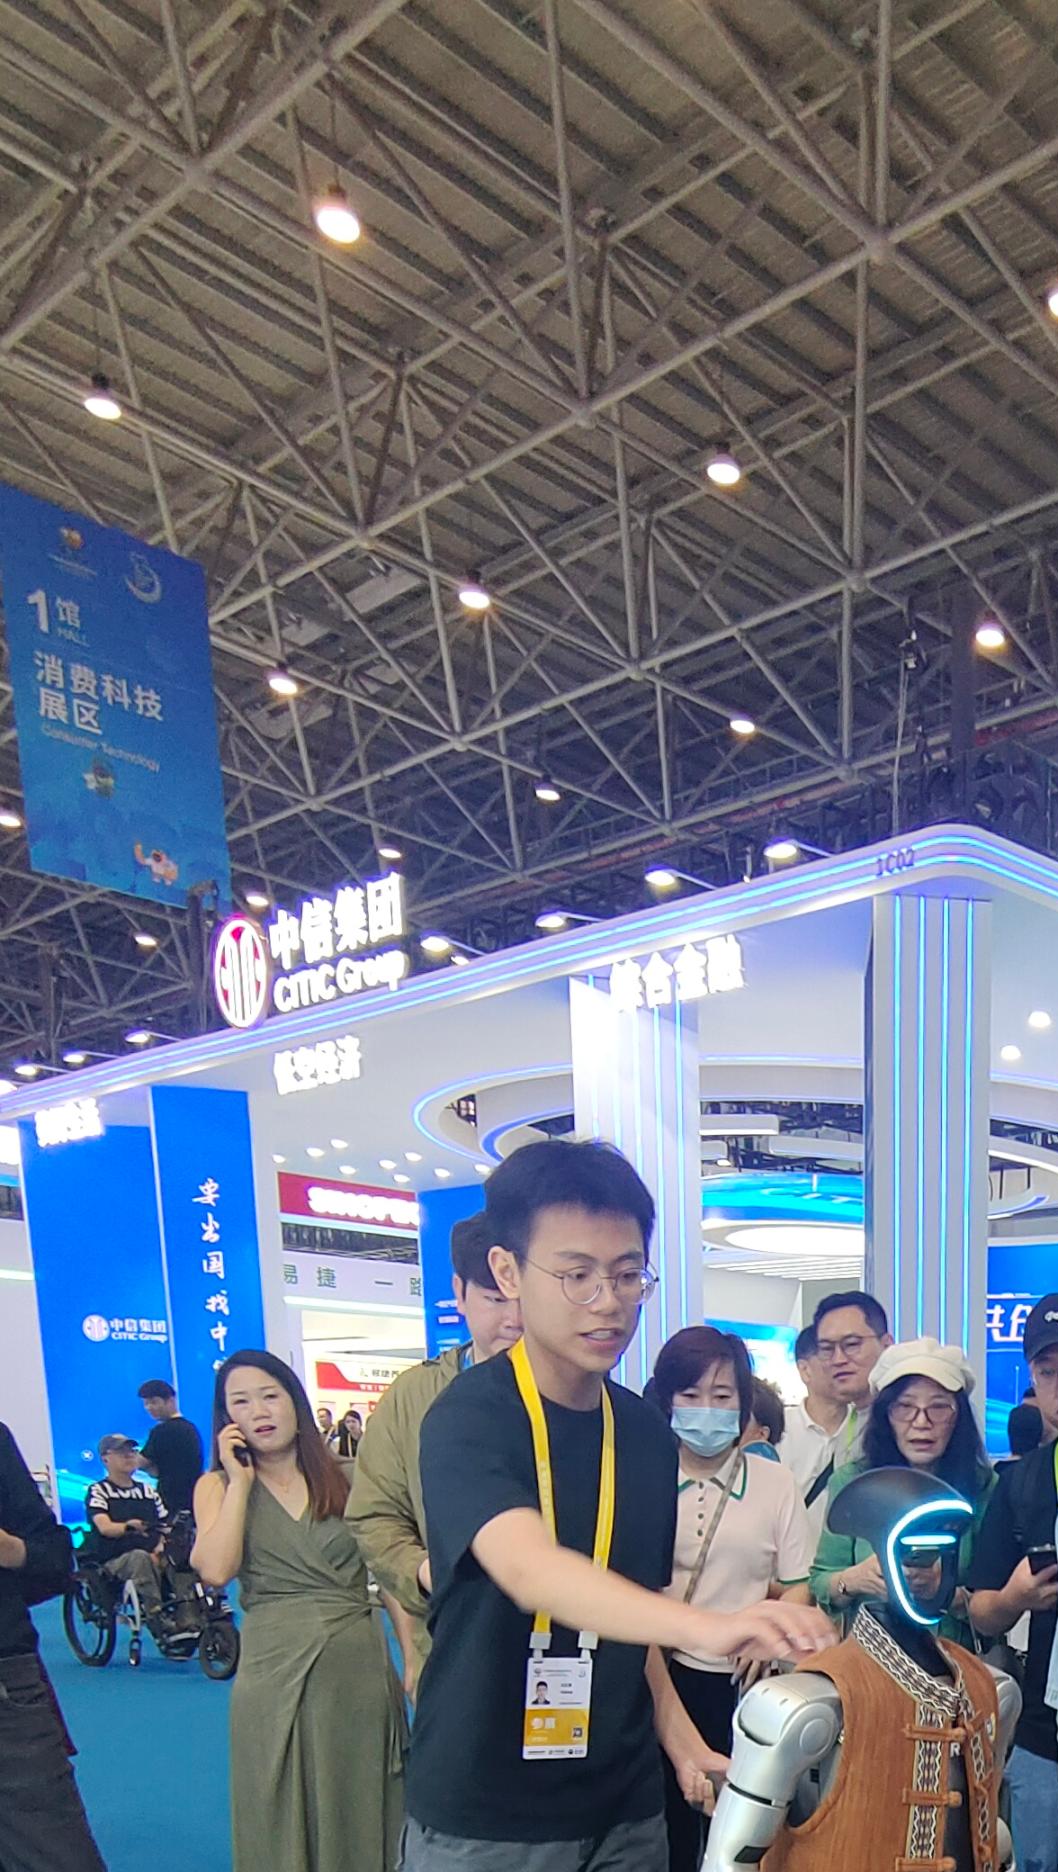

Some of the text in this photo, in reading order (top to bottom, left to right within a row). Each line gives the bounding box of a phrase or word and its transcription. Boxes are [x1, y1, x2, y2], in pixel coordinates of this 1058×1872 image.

[35, 651, 164, 721] 消费科技
[40, 687, 103, 735] 展区
[268, 871, 403, 970] 中信集团
[273, 949, 407, 1012] CITIC Group
[192, 1177, 230, 1371] 要出国找中
[110, 1317, 167, 1334] 中信集团
[111, 1331, 168, 1344] CITIC Group
